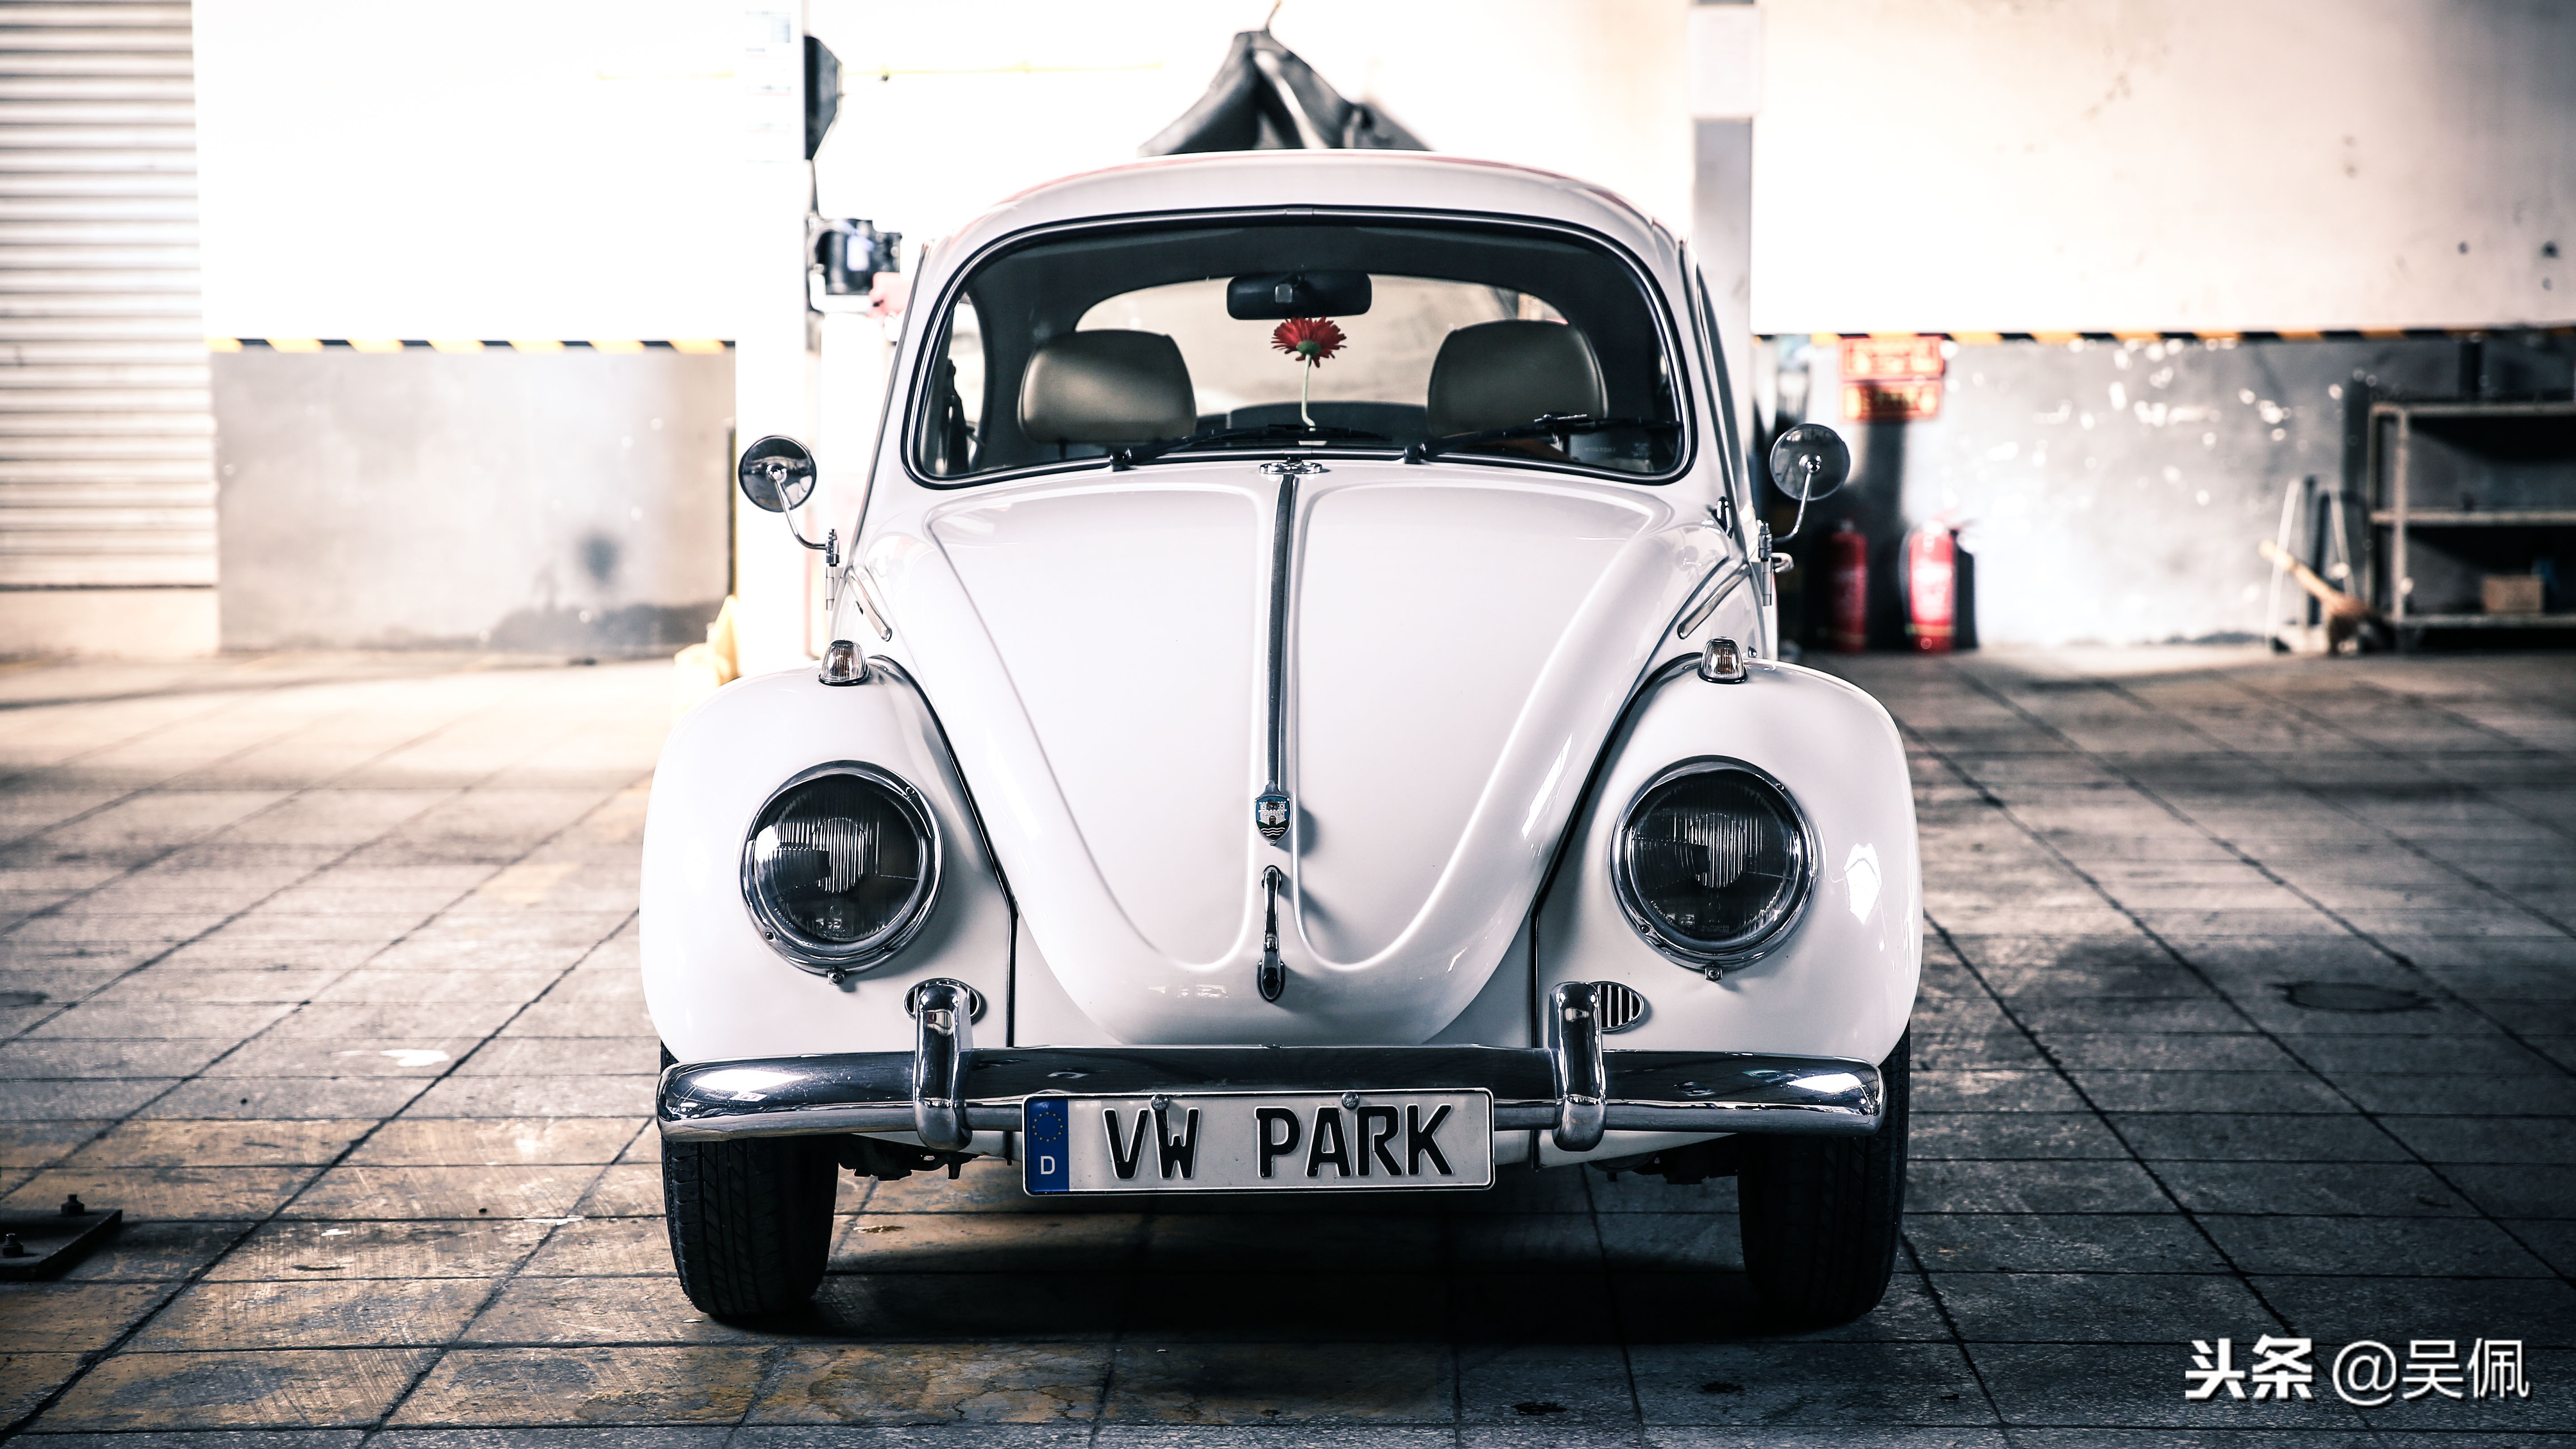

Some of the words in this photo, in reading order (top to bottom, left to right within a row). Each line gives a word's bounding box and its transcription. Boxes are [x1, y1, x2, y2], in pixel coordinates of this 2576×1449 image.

[1040, 1156, 1055, 1174] D
[1103, 1107, 1199, 1180] VW
[1254, 1104, 1453, 1178] PARK
